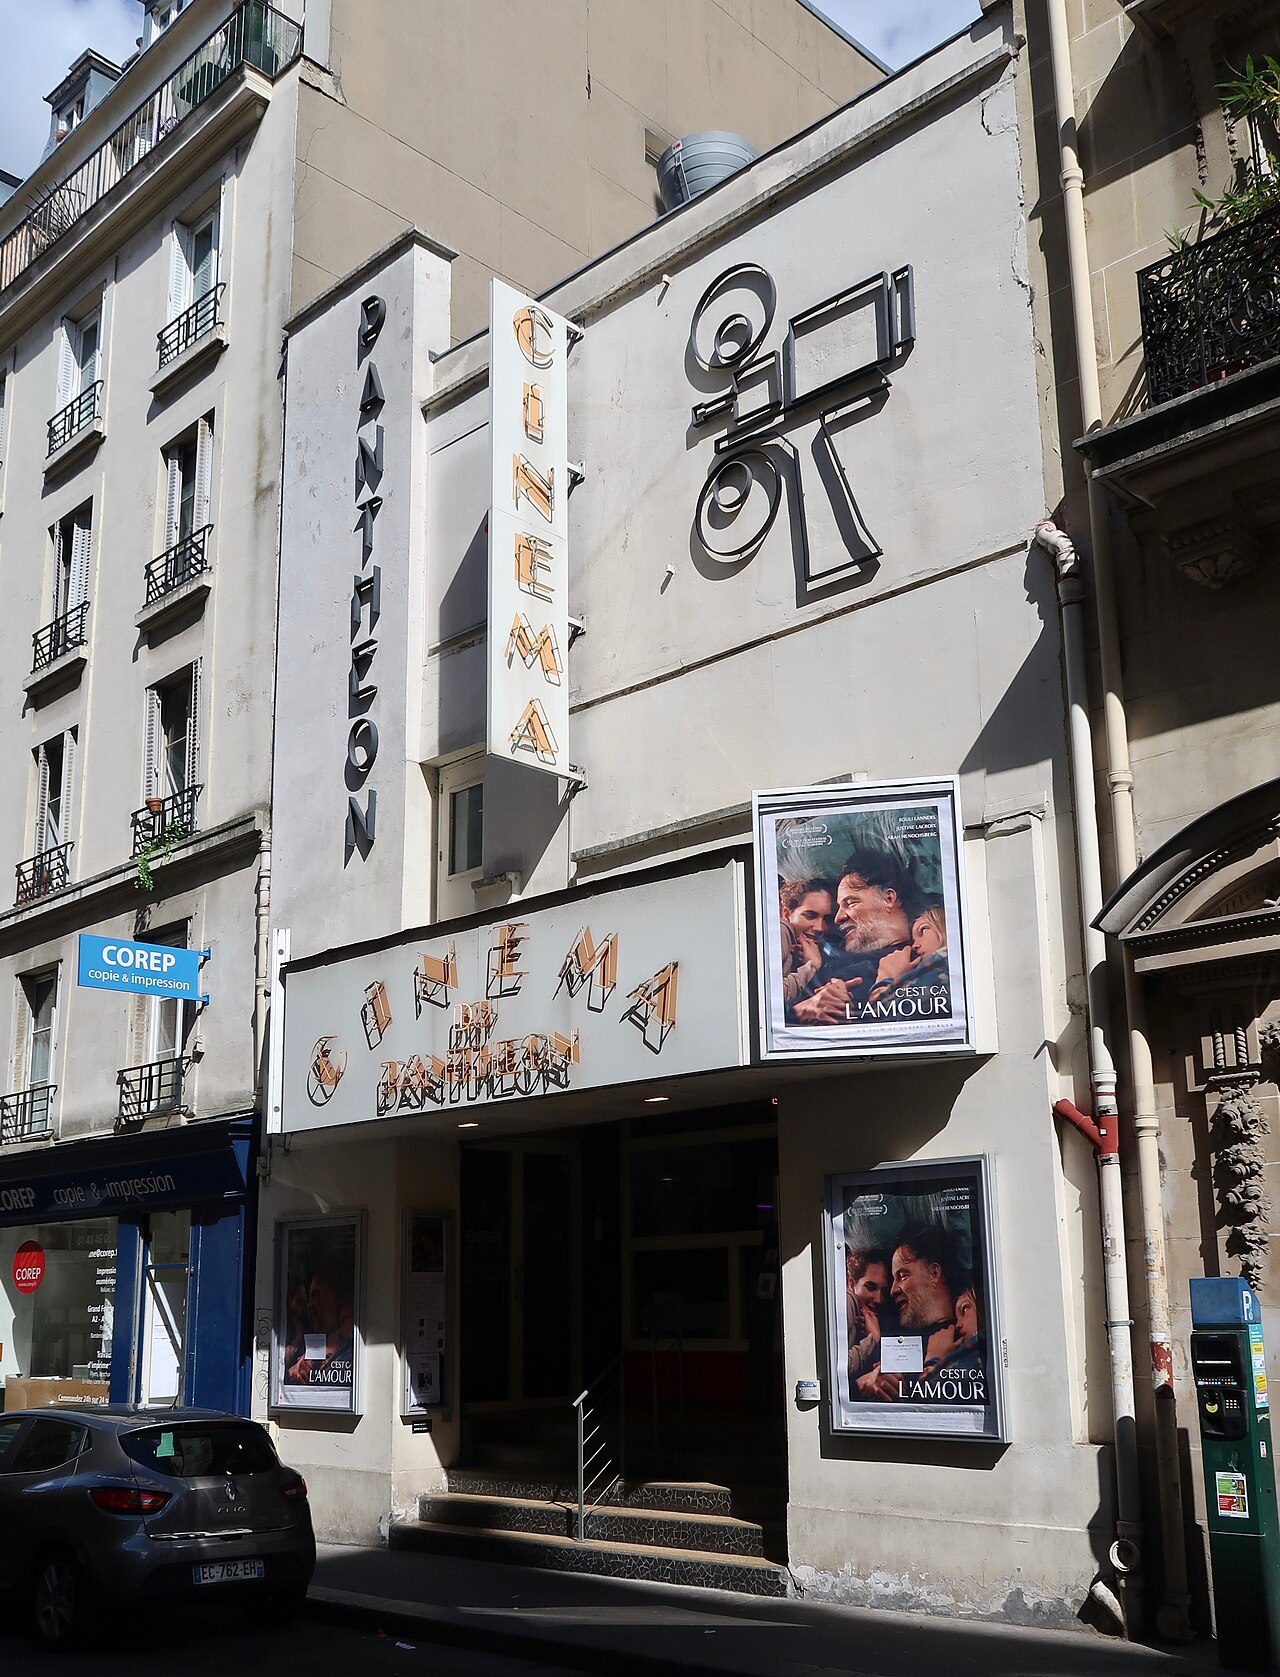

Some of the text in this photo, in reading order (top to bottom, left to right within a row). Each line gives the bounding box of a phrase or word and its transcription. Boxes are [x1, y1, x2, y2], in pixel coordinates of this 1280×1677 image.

[503, 304, 564, 766] CINEMA
[344, 294, 388, 866] PANTHEON
[102, 945, 176, 973] COREP
[88, 968, 190, 991] copie & impression
[930, 985, 948, 997] ÇA
[306, 921, 680, 1107] CINEMA
[845, 996, 950, 1020] L'AMOUR
[376, 1026, 581, 1116] PANTHEON
[53, 1182, 86, 1208] copie
[90, 1182, 102, 1200] &
[104, 1171, 176, 1202] impression
[15, 1267, 41, 1281] COREP
[309, 1369, 352, 1384] L'AMOUR
[968, 1369, 985, 1381] ÇA
[898, 1380, 986, 1400] L'AMOUR
[201, 1561, 256, 1580] EC-762-EH
